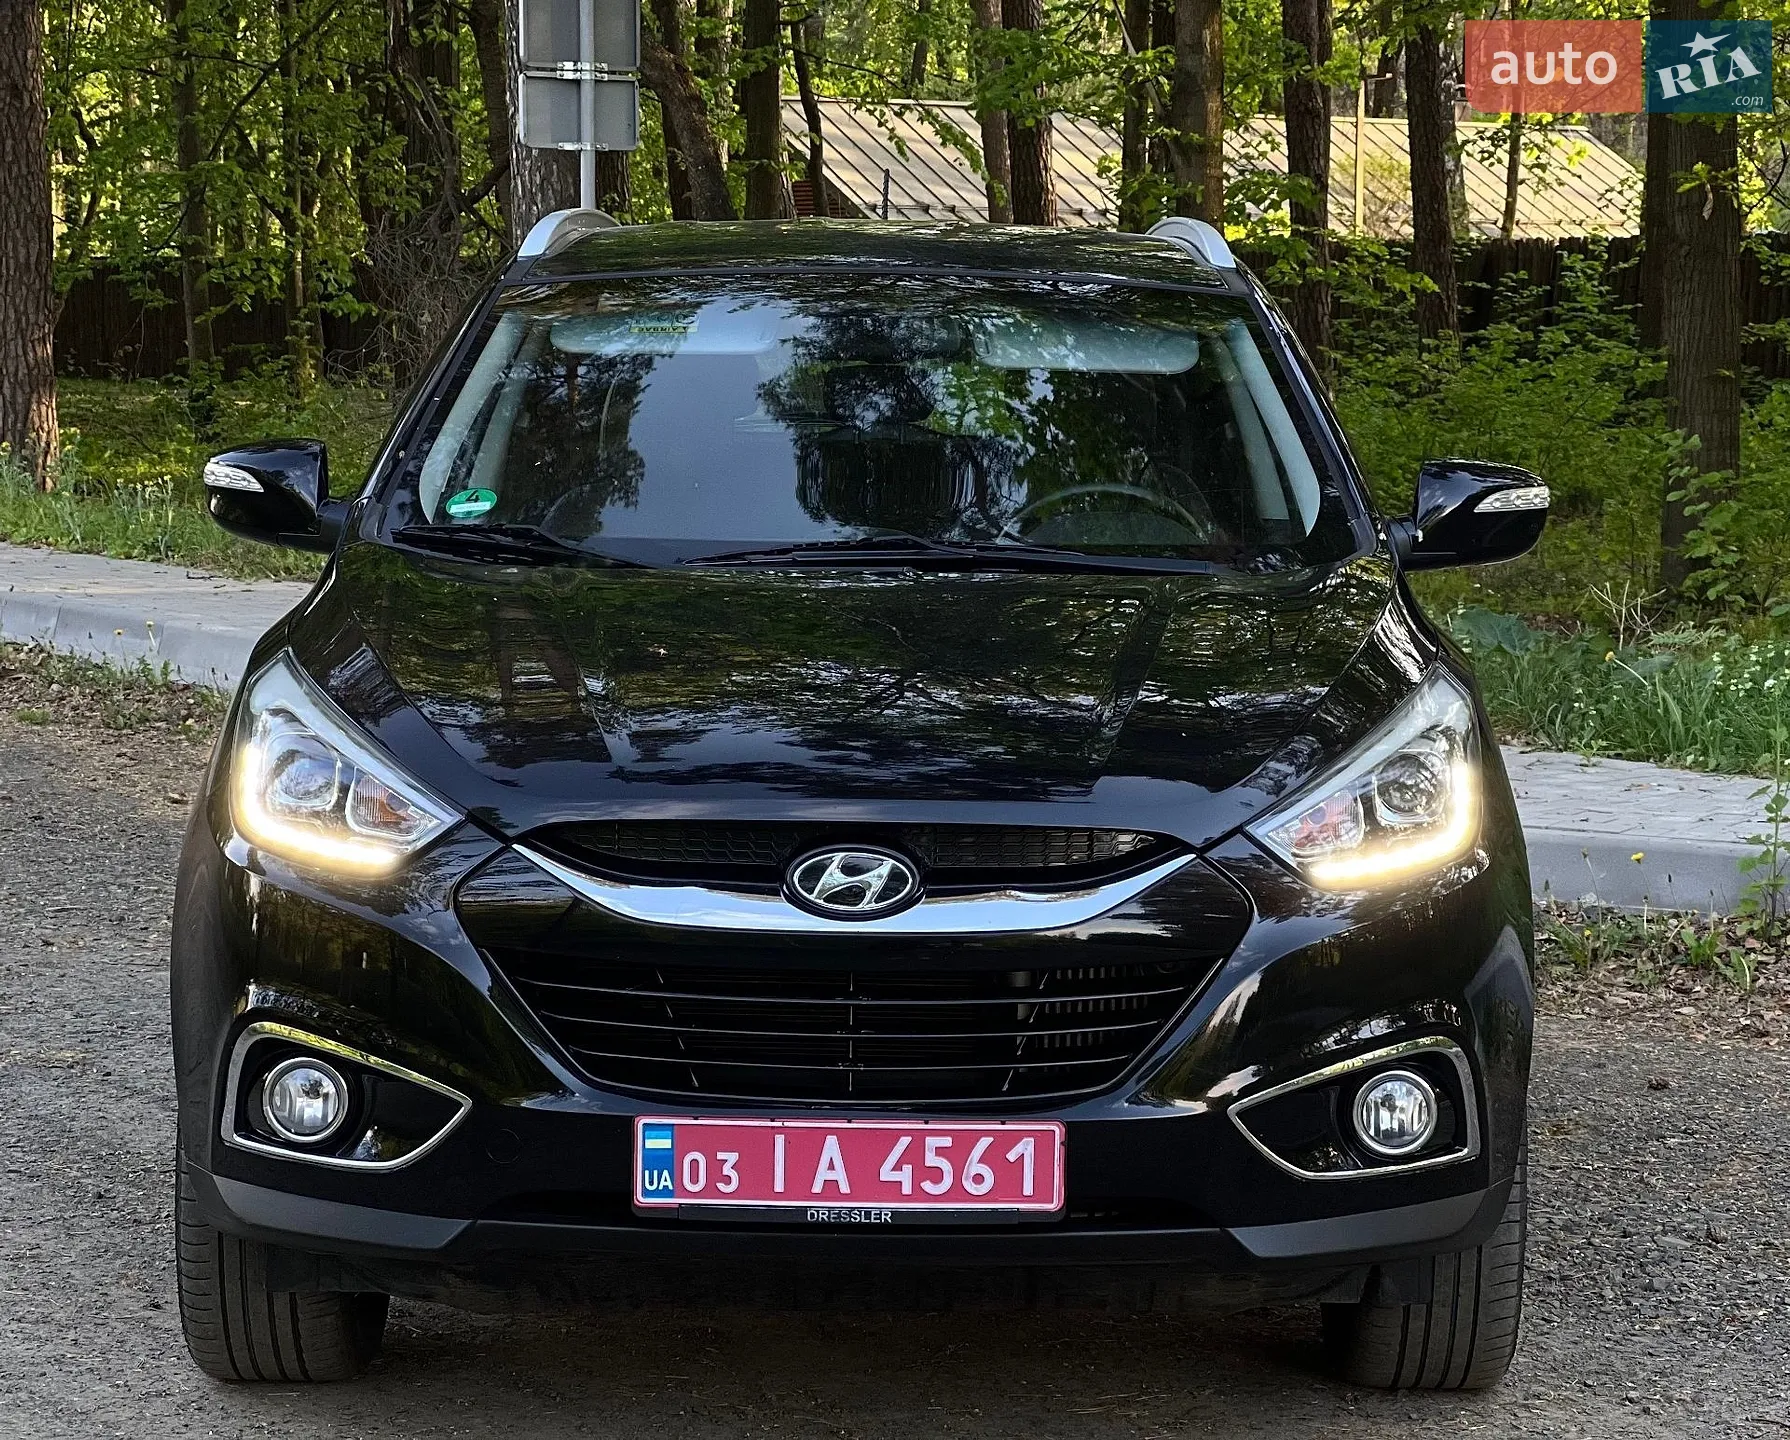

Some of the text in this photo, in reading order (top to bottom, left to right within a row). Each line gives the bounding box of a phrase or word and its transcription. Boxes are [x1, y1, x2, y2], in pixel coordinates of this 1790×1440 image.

[465, 489, 480, 503] 4
[644, 1170, 674, 1191] UA
[682, 1151, 739, 1193] 03
[879, 1136, 1035, 1196] 4561
[807, 1208, 892, 1224] DRESSLER
